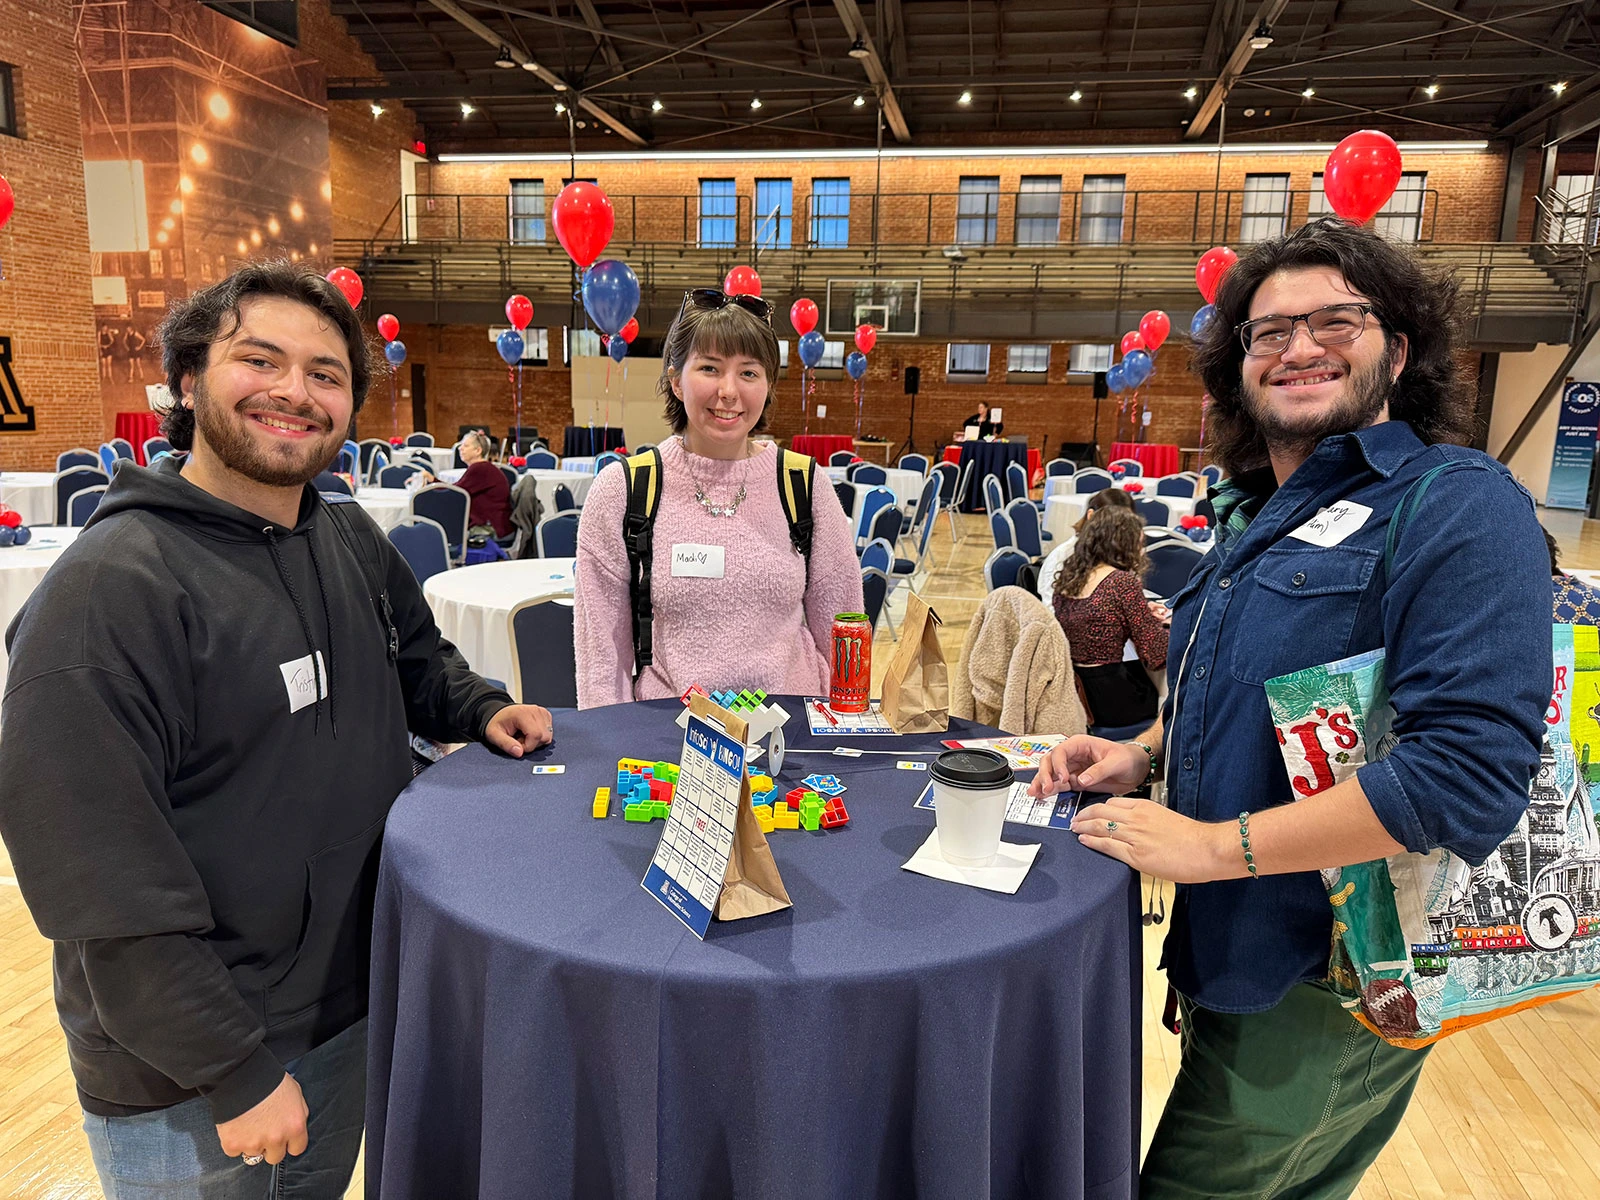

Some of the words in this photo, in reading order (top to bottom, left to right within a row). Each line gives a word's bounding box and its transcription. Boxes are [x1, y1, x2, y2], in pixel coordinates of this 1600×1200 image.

[1571, 393, 1594, 403] SOS
[676, 553, 698, 563] Madi
[718, 744, 741, 772] BINGO!
